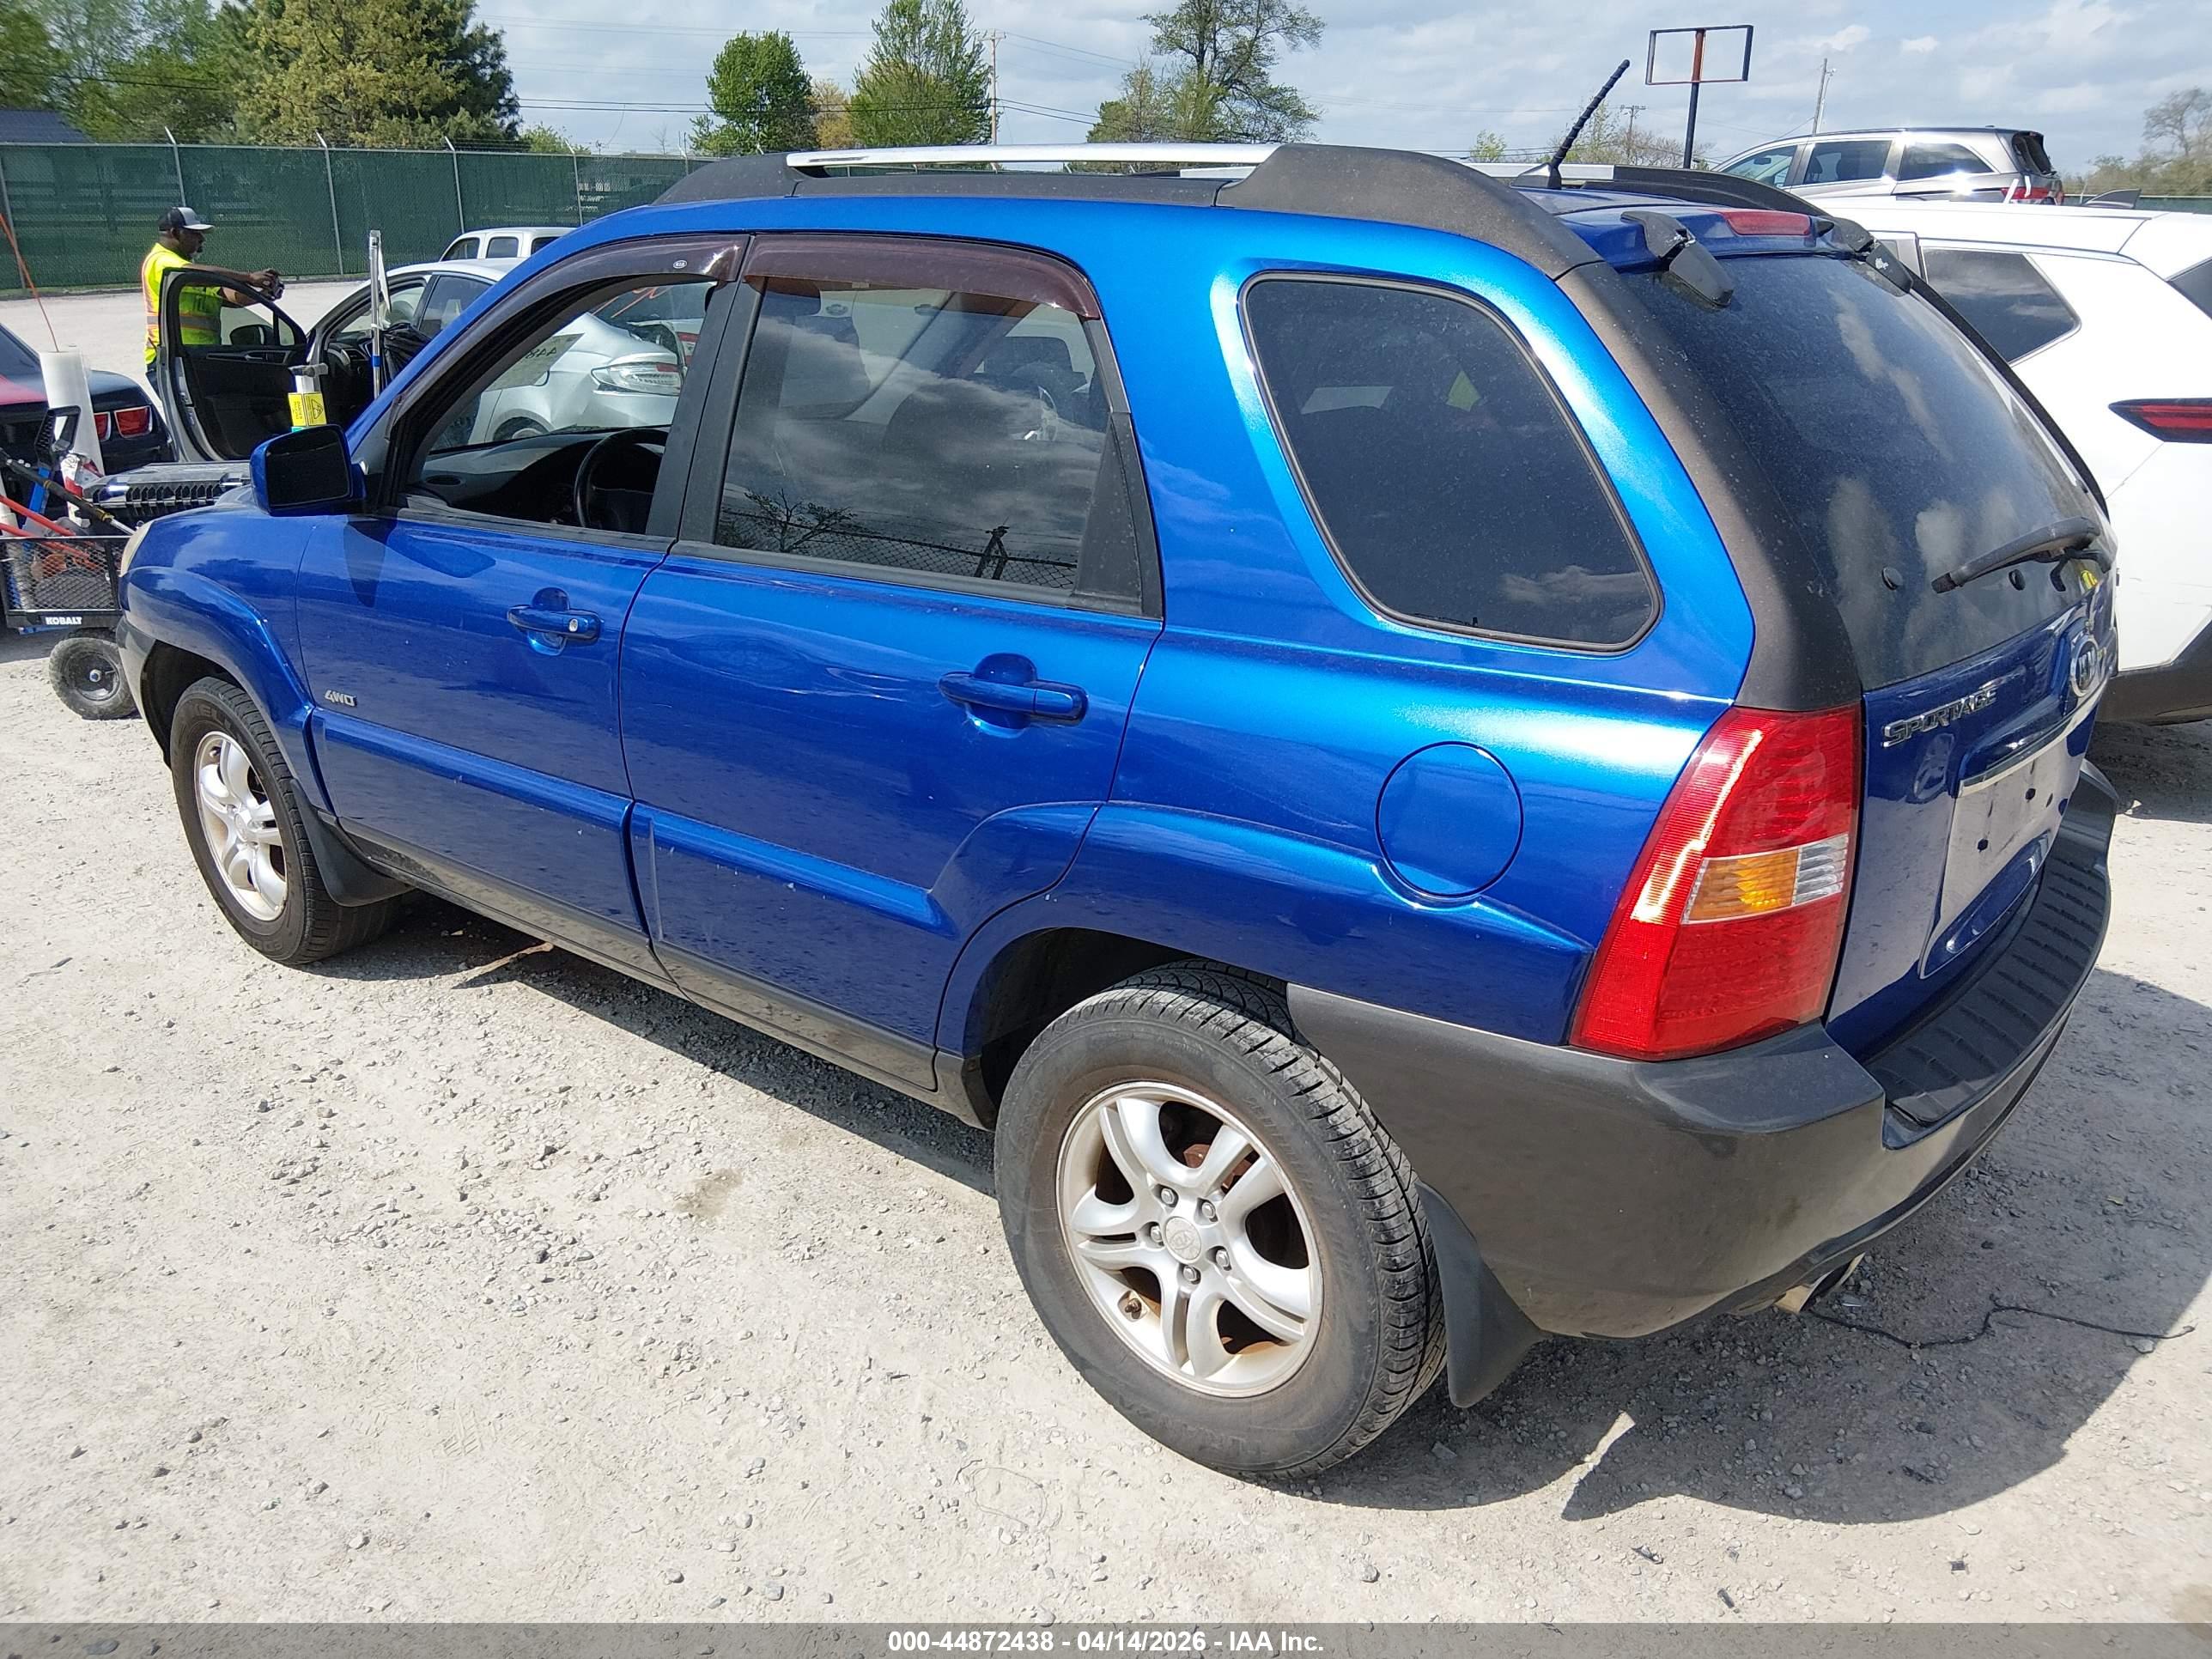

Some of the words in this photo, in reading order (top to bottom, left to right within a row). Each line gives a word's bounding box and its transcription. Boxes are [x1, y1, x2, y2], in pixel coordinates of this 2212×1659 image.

[45, 617, 82, 625] KOBALT
[325, 690, 357, 707] 4WD
[1883, 684, 1997, 748] SPORTAGE
